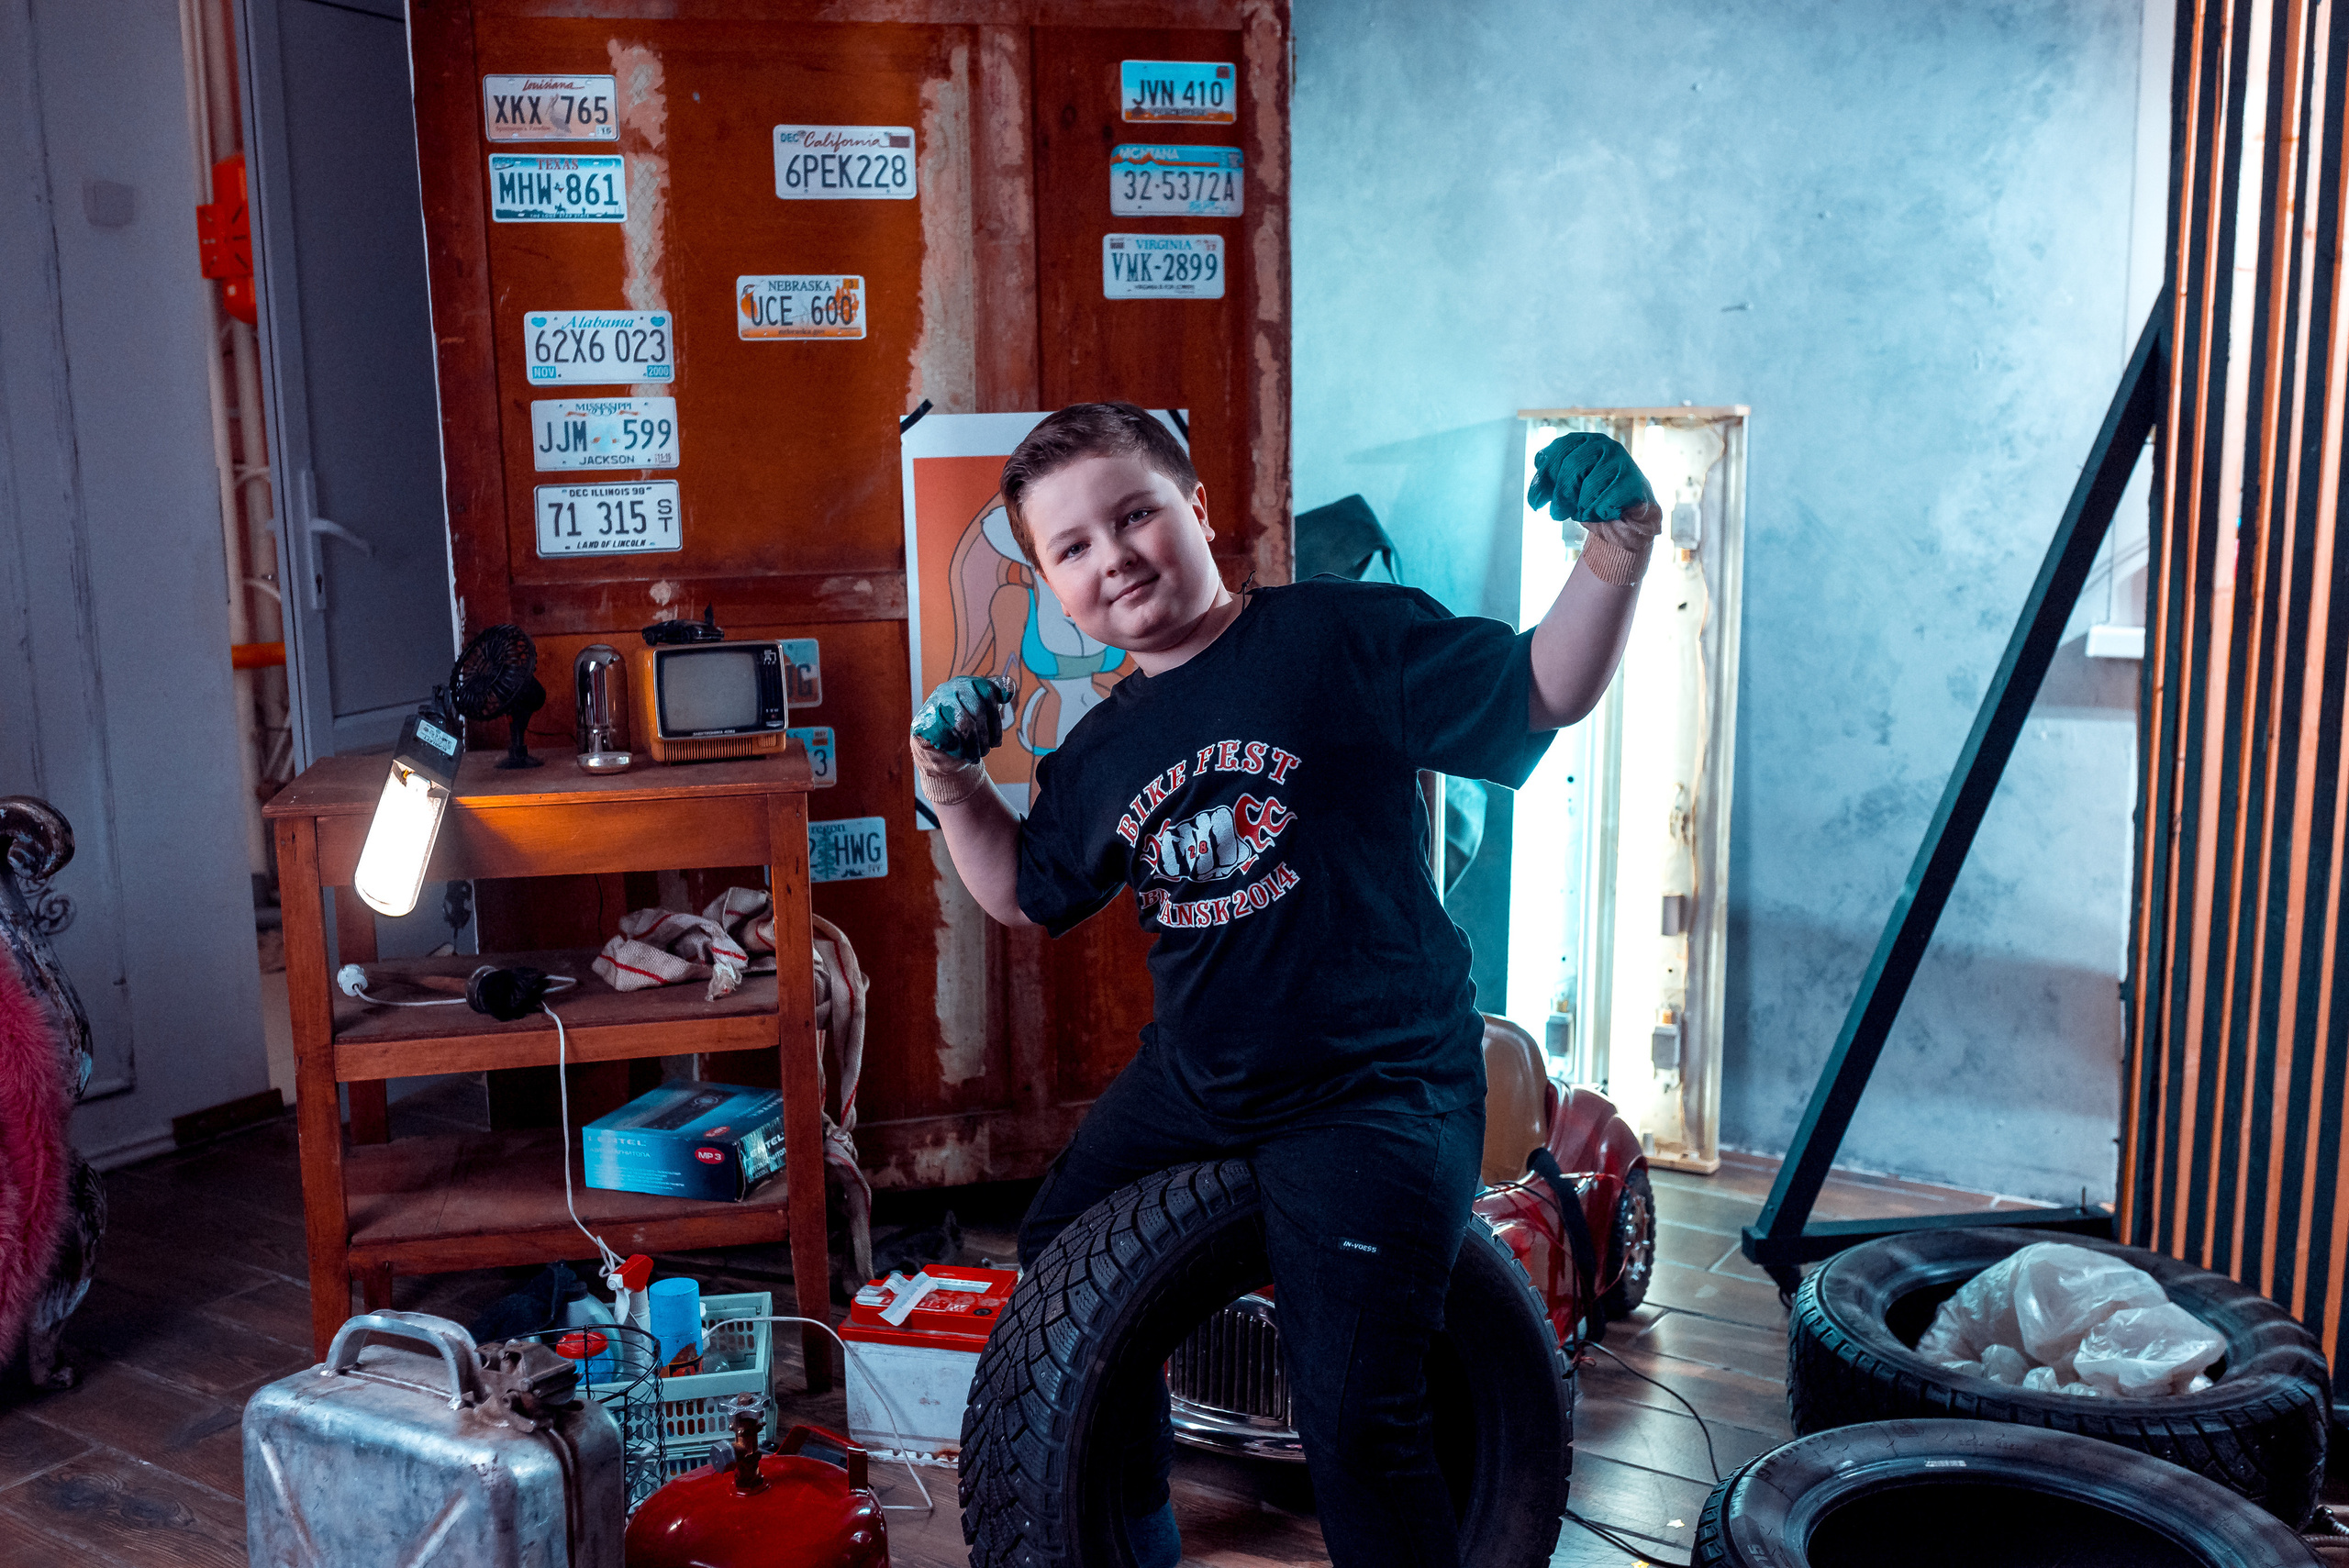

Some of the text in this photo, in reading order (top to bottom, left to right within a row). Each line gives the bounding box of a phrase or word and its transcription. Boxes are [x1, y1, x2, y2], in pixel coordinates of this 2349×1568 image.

[522, 78, 584, 92] Louisiana
[1132, 80, 1223, 106] JVN 410
[493, 95, 608, 125] XKX 765
[780, 131, 890, 152] DEC California
[536, 159, 579, 170] TEXAS
[785, 154, 907, 188] 6PEK228
[498, 172, 619, 206] MHW 861
[1135, 239, 1192, 250] VIRGINIA
[1111, 252, 1218, 282] VMK-2899
[768, 280, 831, 292] NEBRASKA
[751, 295, 852, 327] UCE 600
[561, 316, 635, 329] Alabama
[535, 329, 666, 363] 62X6 023
[533, 367, 555, 377] NOV
[648, 366, 669, 376] 2000
[575, 403, 632, 417] MISSISSIPPI
[539, 418, 672, 453] JJM 599
[579, 455, 635, 465] JACKSON
[569, 486, 645, 497] DEC ILLINOIS 98
[548, 500, 647, 538] 71 315
[576, 541, 599, 550] LAND
[612, 539, 647, 548] LINCOLN
[1116, 740, 1302, 849] BIKE FEST
[808, 824, 846, 835] regon
[834, 832, 881, 865] HWG
